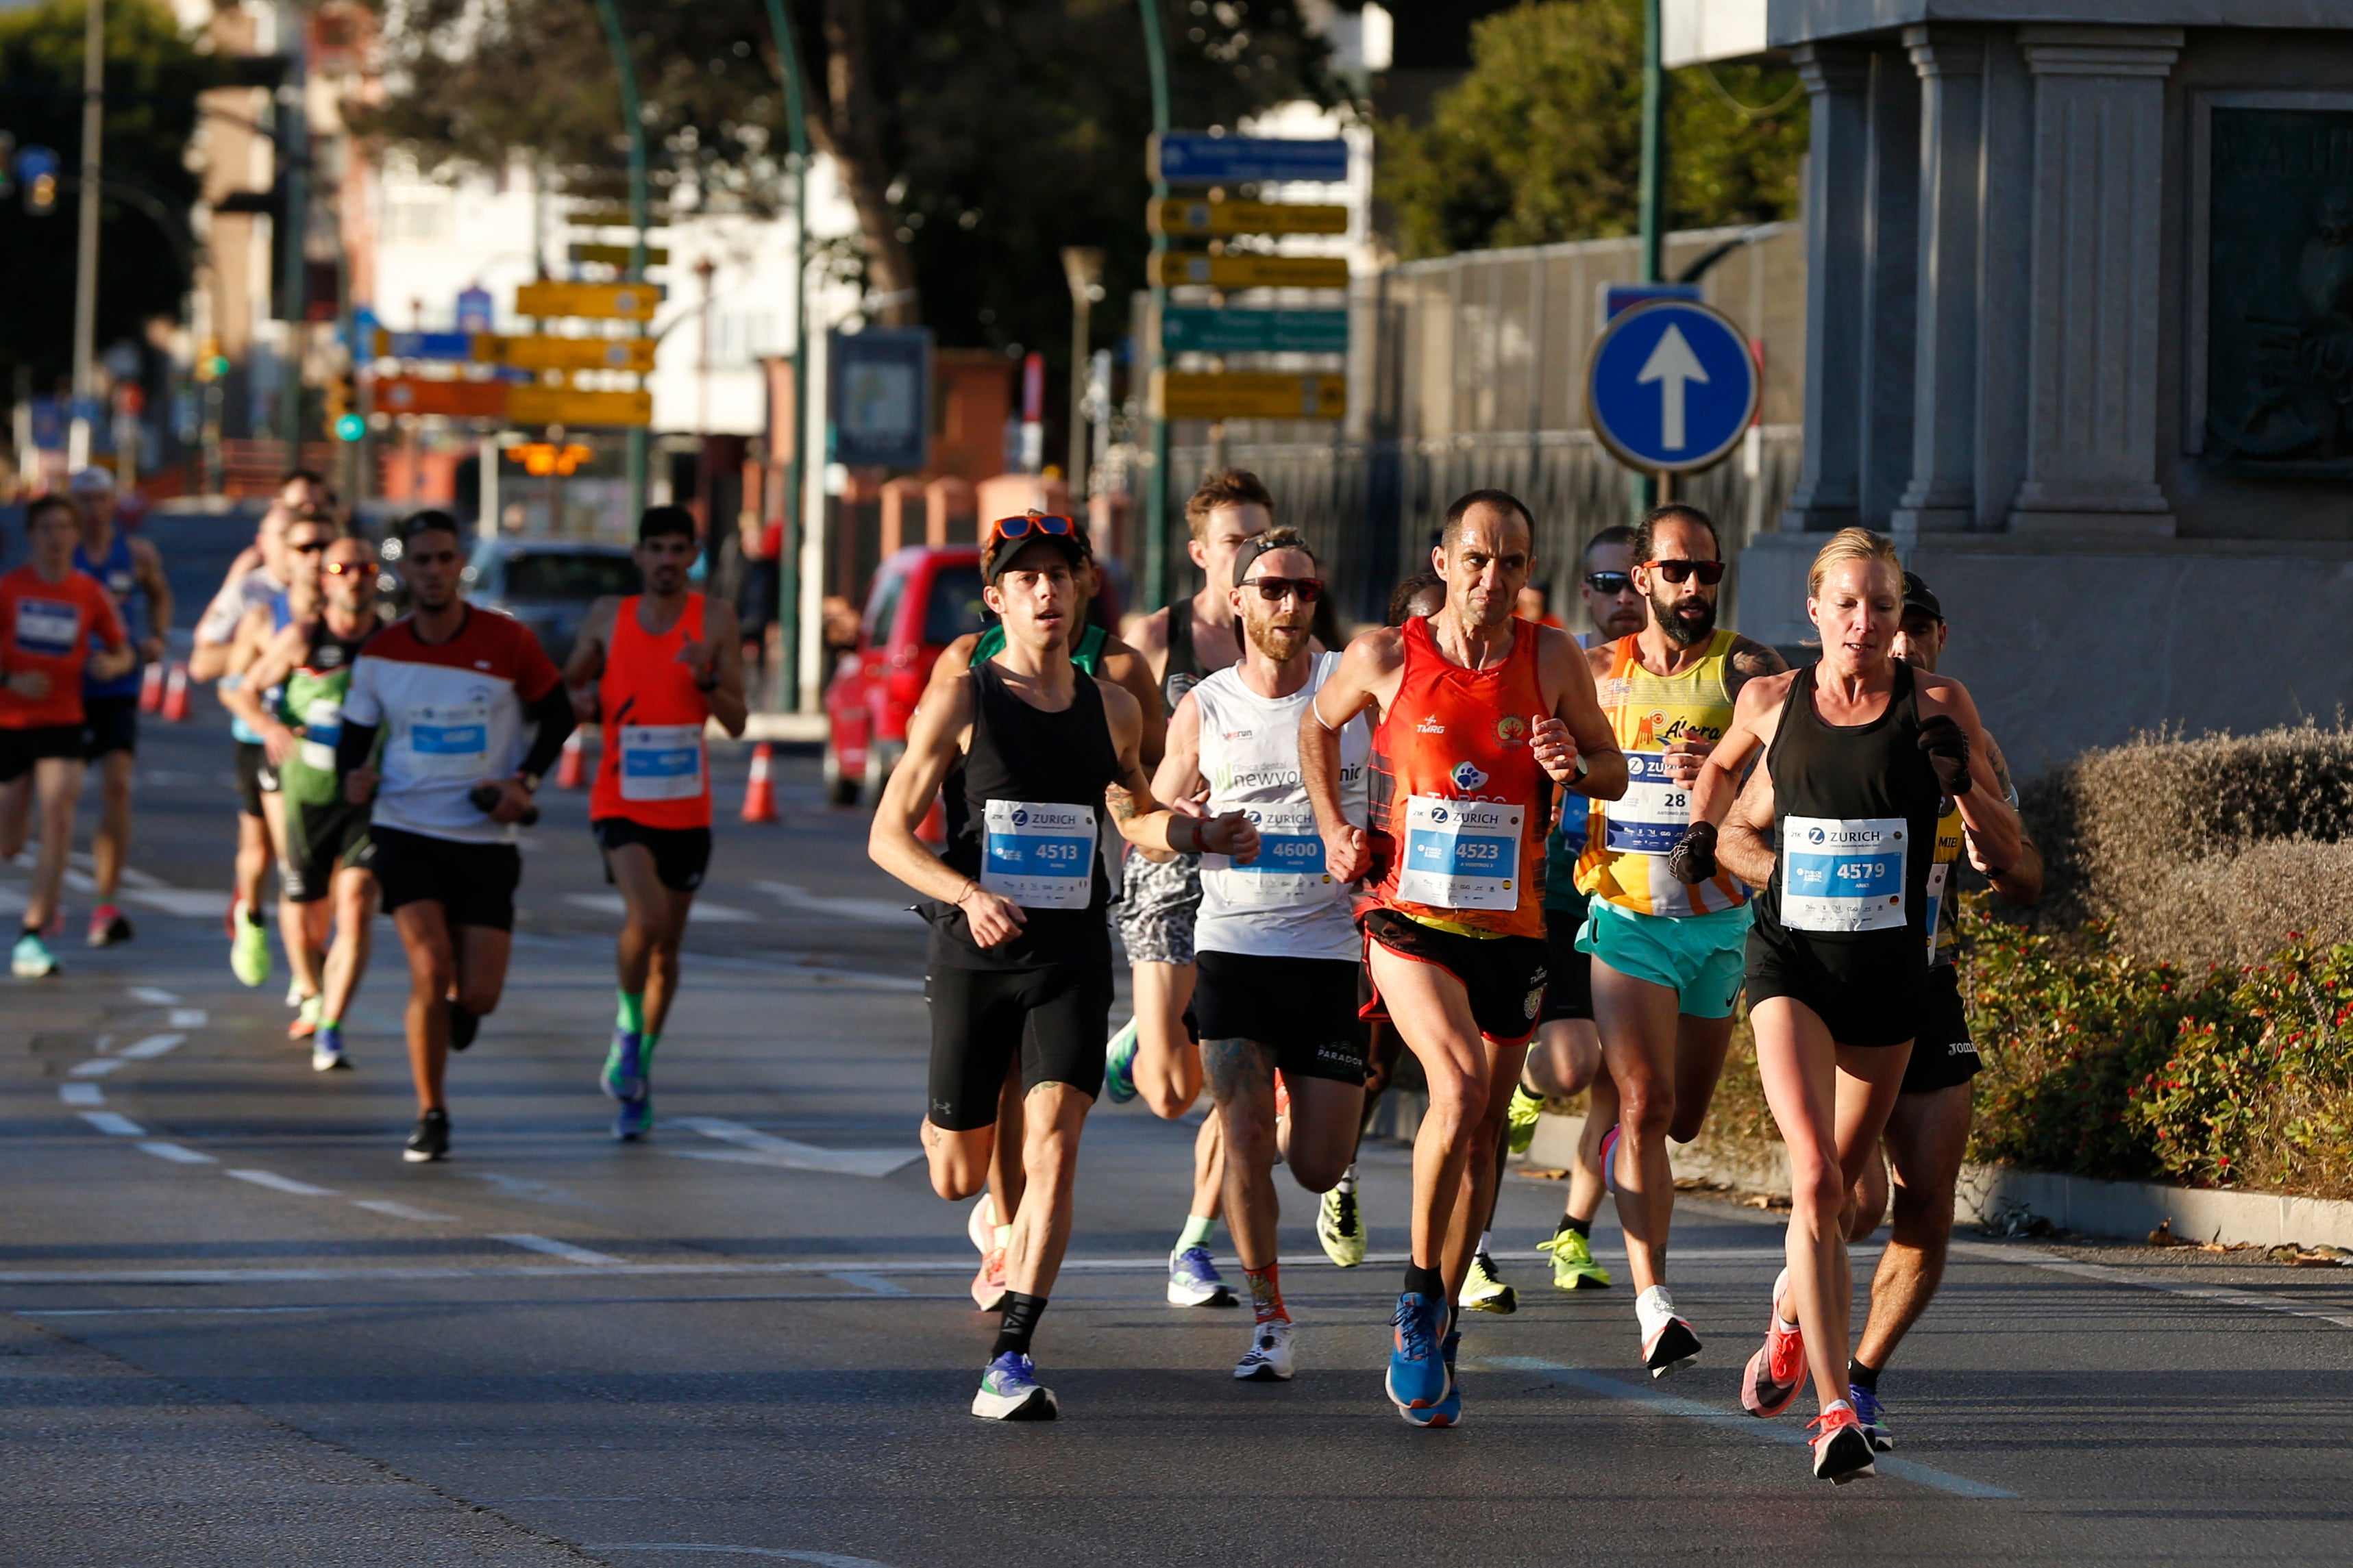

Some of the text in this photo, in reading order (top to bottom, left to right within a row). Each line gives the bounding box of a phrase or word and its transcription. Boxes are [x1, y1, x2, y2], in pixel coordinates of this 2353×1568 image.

[1417, 725, 1445, 734] TMRG
[1261, 761, 1287, 771] dental
[1665, 794, 1686, 807] 28
[1032, 814, 1076, 825] ZURICH
[1267, 814, 1311, 824] ZURICH
[1453, 812, 1499, 824] ZURICH
[1830, 831, 1880, 843] ZURICH
[1036, 844, 1078, 860] 4513
[1273, 843, 1317, 857] 4600
[1456, 843, 1499, 859] 4523
[1837, 862, 1885, 879] 4579
